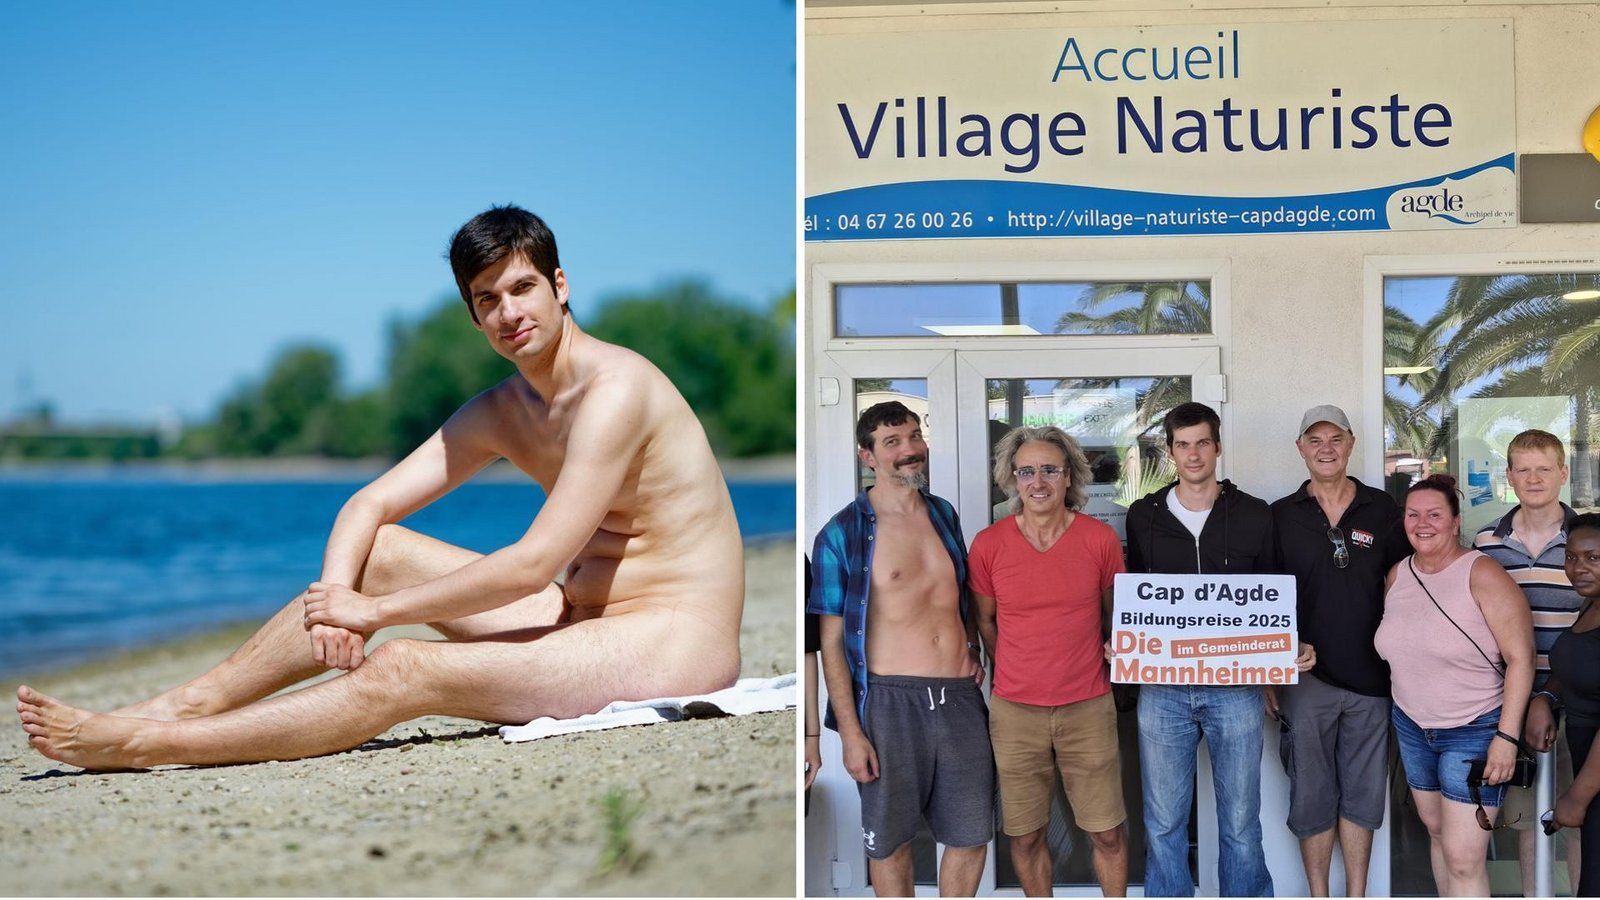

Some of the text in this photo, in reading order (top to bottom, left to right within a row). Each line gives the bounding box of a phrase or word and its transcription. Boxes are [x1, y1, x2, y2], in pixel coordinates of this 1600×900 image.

[1052, 30, 1239, 82] Accueil
[838, 88, 1453, 173] Village Naturiste
[1401, 188, 1463, 218] agde
[1465, 210, 1493, 219] Archipel
[838, 214, 860, 230] 04
[866, 213, 887, 229] 67
[894, 212, 916, 229] 26
[922, 212, 944, 228] 00
[951, 211, 973, 228] 26
[1008, 205, 1376, 228] http://village-naturiste-capdagde.com
[1084, 414, 1108, 423] EXIT
[1351, 531, 1374, 544] QUICKY
[1137, 582, 1279, 606] Cap d’Agde
[1121, 612, 1291, 629] Bildungsreise 2025
[1116, 630, 1162, 655] Die
[1177, 638, 1286, 655] im Gemeinderat
[1115, 658, 1295, 684] Mannheimer
